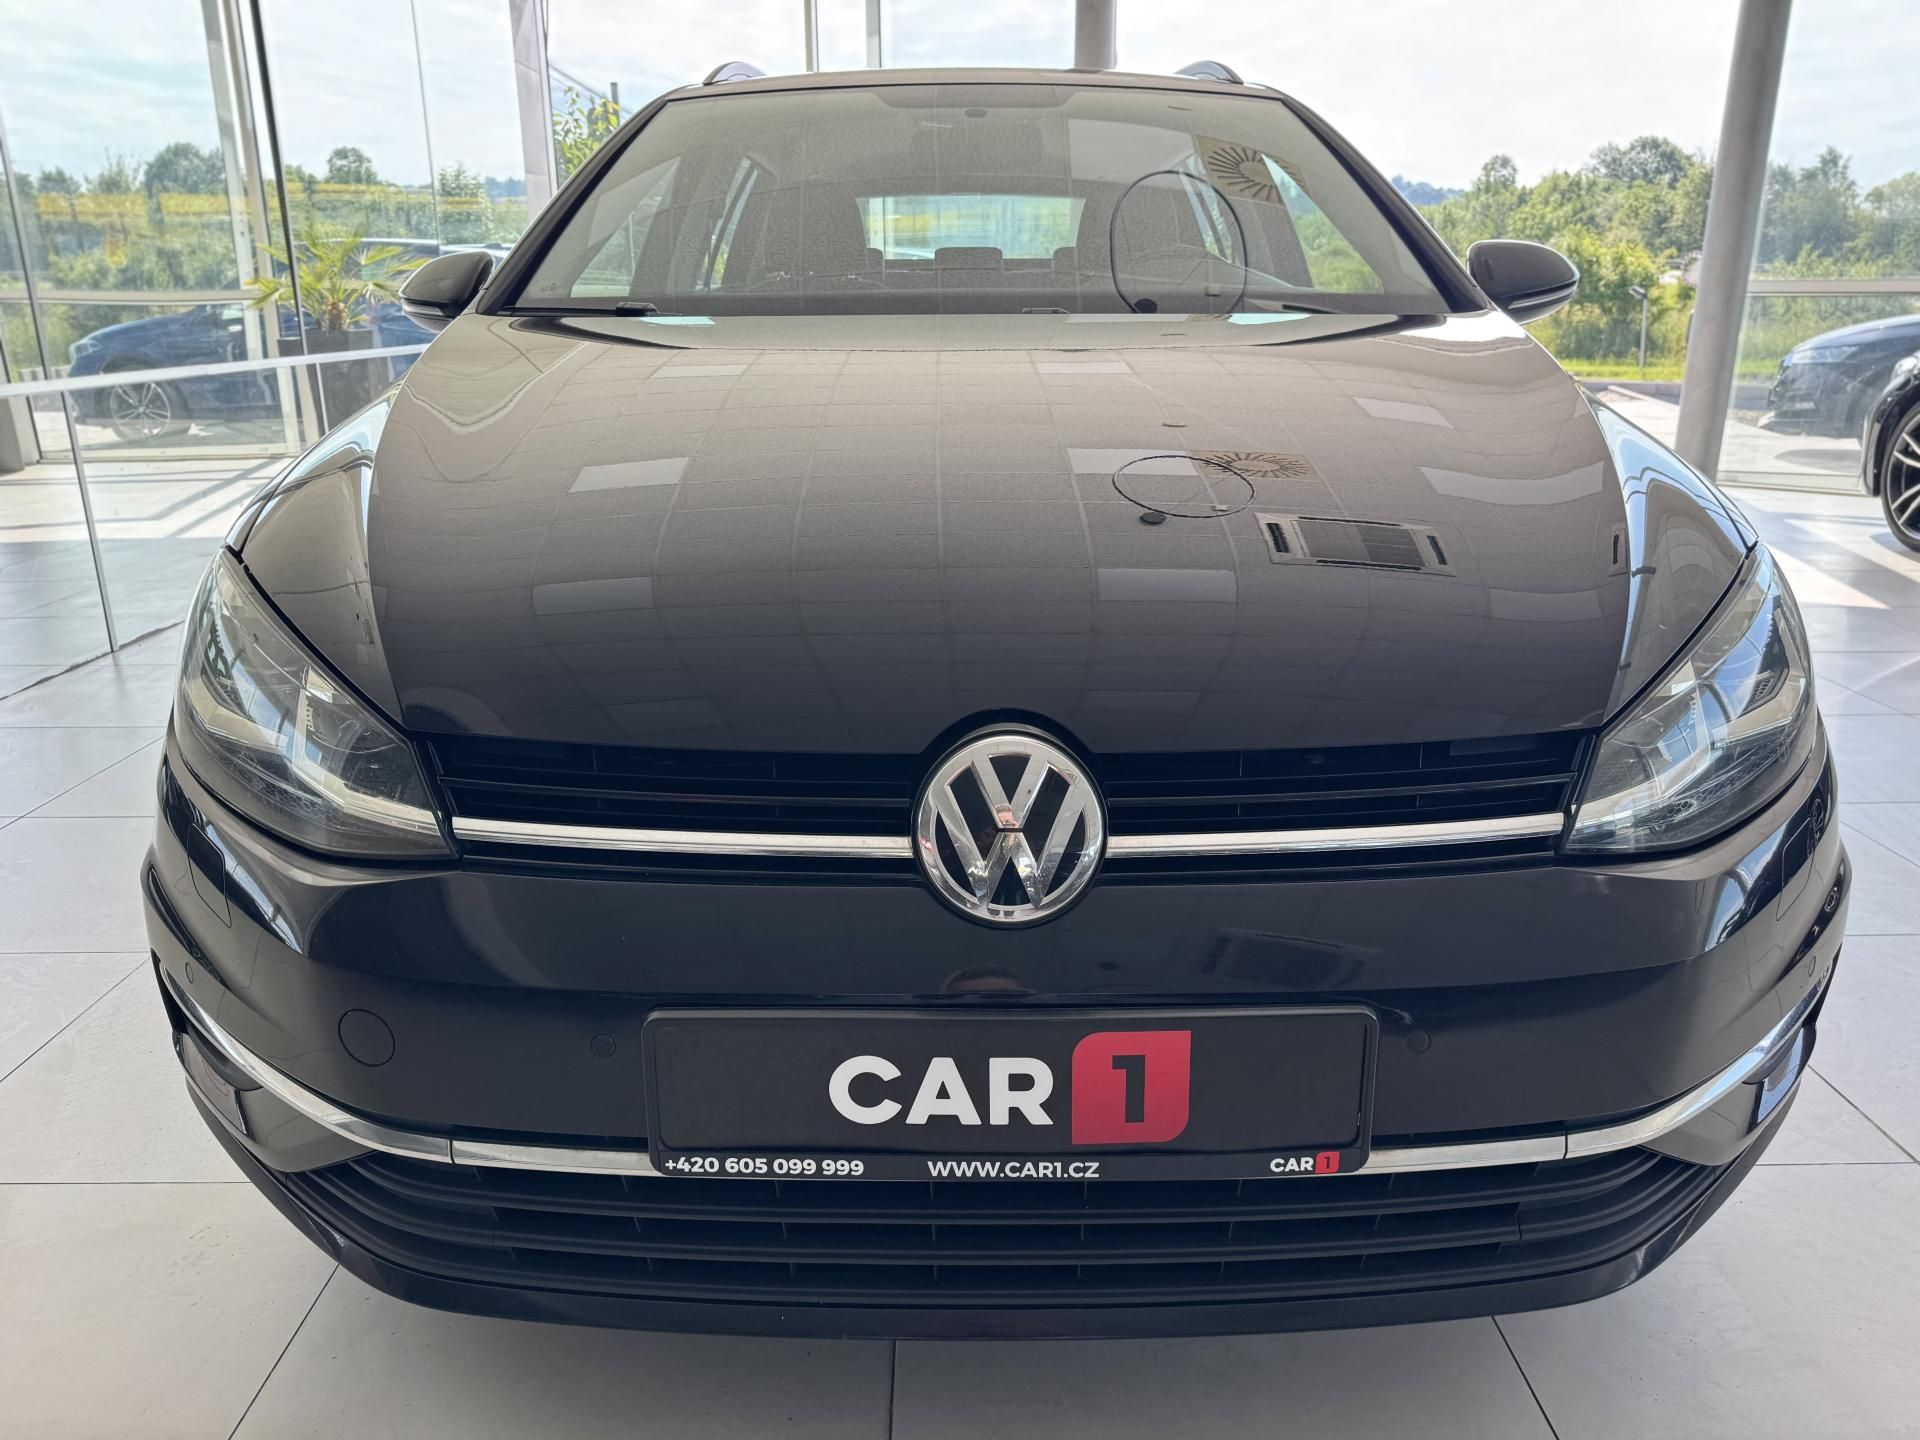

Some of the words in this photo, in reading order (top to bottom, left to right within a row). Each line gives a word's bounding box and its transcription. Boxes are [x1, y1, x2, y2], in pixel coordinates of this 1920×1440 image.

[925, 739, 1095, 916] VW
[828, 1055, 1054, 1126] CAR
[1112, 1055, 1146, 1124] 1
[665, 1157, 719, 1173] +420
[724, 1157, 768, 1174] 605
[772, 1158, 817, 1175] 099
[821, 1159, 865, 1176] 999
[927, 1161, 1100, 1178] WWW.CAR1.CZ
[1269, 1156, 1314, 1173] CAR
